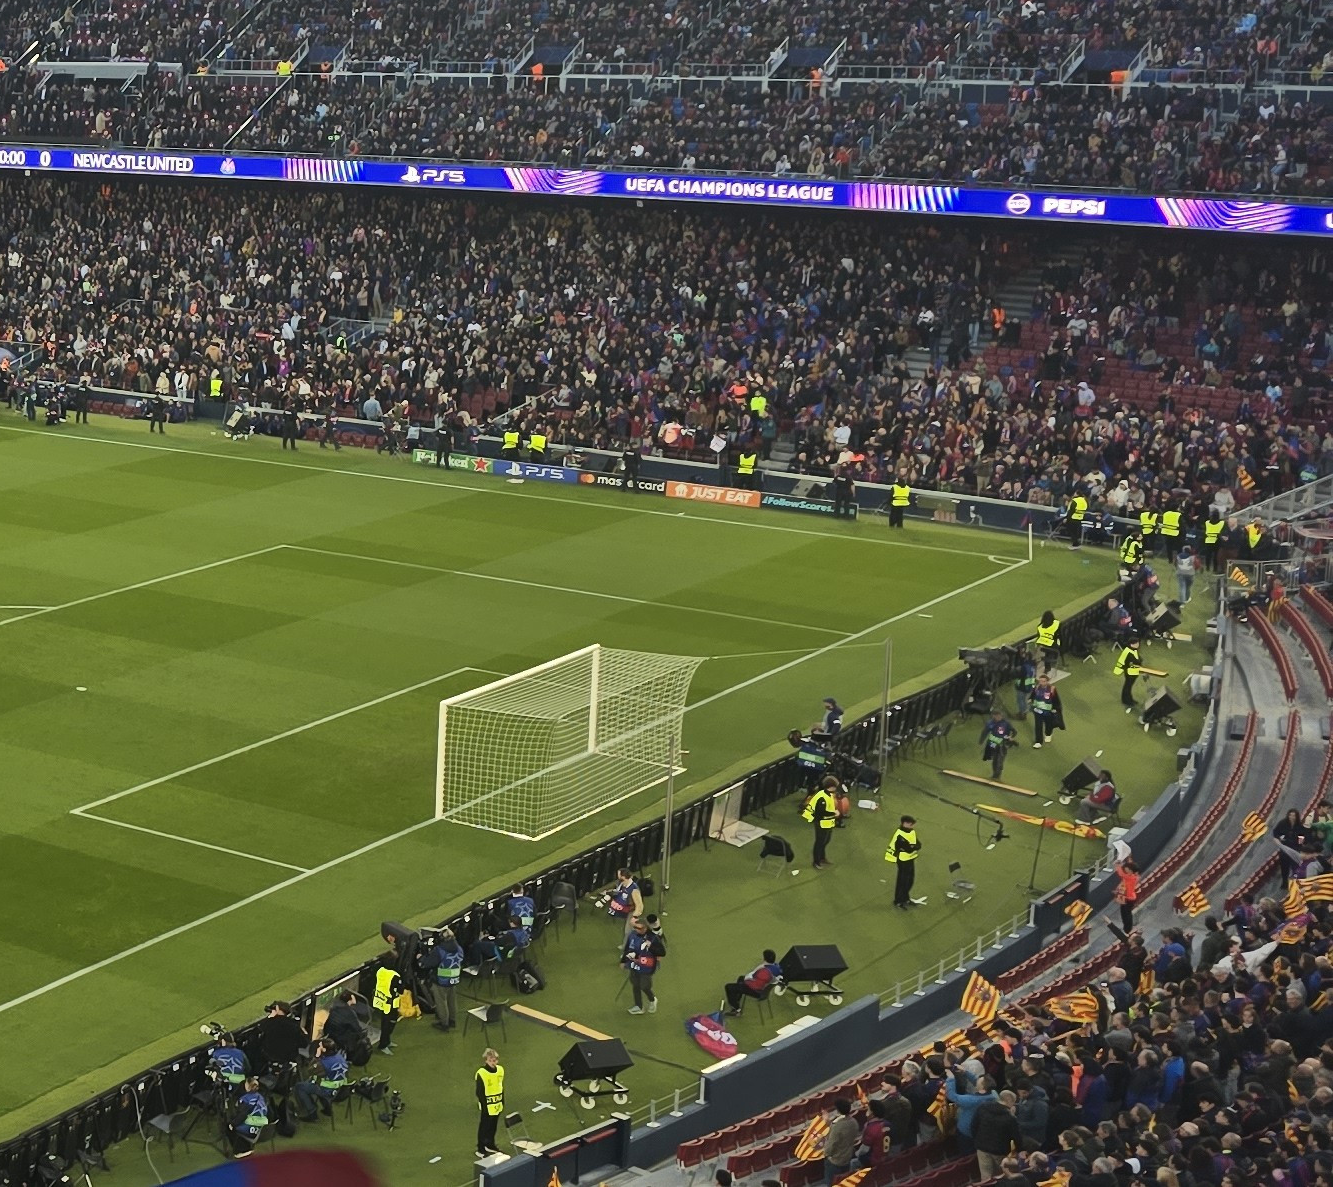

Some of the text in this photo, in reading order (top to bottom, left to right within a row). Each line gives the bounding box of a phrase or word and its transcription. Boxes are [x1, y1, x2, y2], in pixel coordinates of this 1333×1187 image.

[40, 150, 51, 167] 0
[73, 152, 147, 170] NEWCASTLE
[147, 156, 194, 172] UNITED
[422, 169, 465, 183] PS5
[625, 178, 834, 201] UEFA CHAMPIONS LEAGUE
[1043, 197, 1106, 216] PEPSI
[525, 465, 565, 480] PS5
[689, 486, 754, 504] JUST EAT
